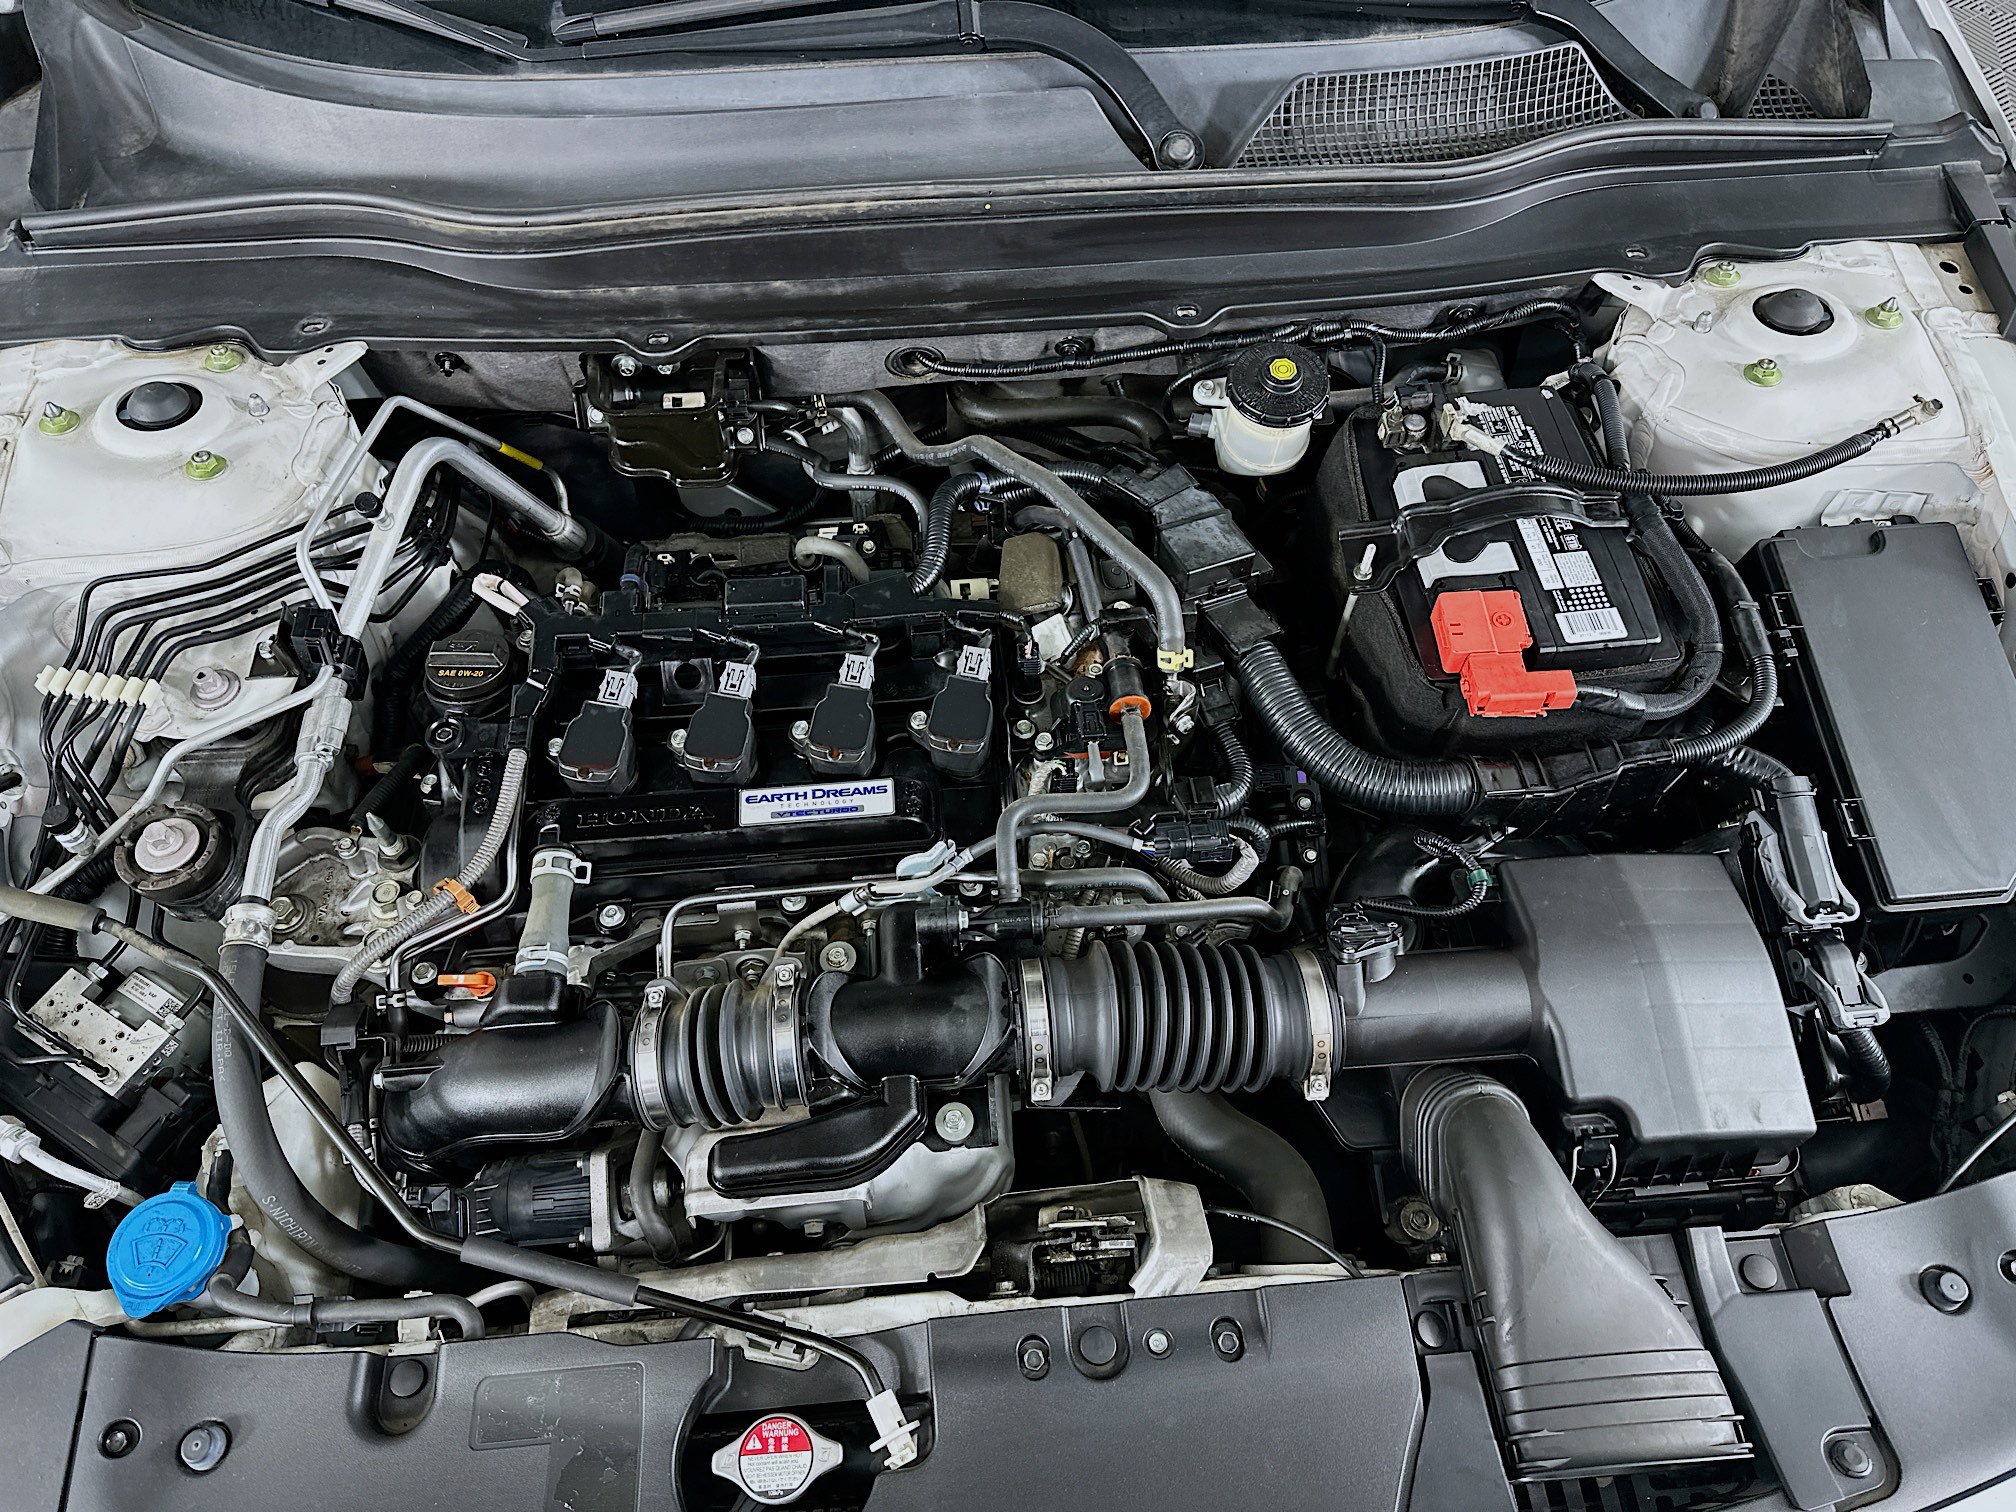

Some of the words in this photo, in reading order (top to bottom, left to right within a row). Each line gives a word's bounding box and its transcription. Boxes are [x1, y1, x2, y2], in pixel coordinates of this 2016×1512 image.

[438, 669, 457, 677] SAE
[457, 669, 484, 678] 0W-20
[745, 791, 808, 805] EARTH
[811, 785, 888, 800] DREAMS
[780, 798, 854, 809] TECHNOLOGY
[576, 805, 716, 829] HONDA
[762, 1421, 792, 1431] DANGER
[762, 1428, 800, 1438] WARNUNG
